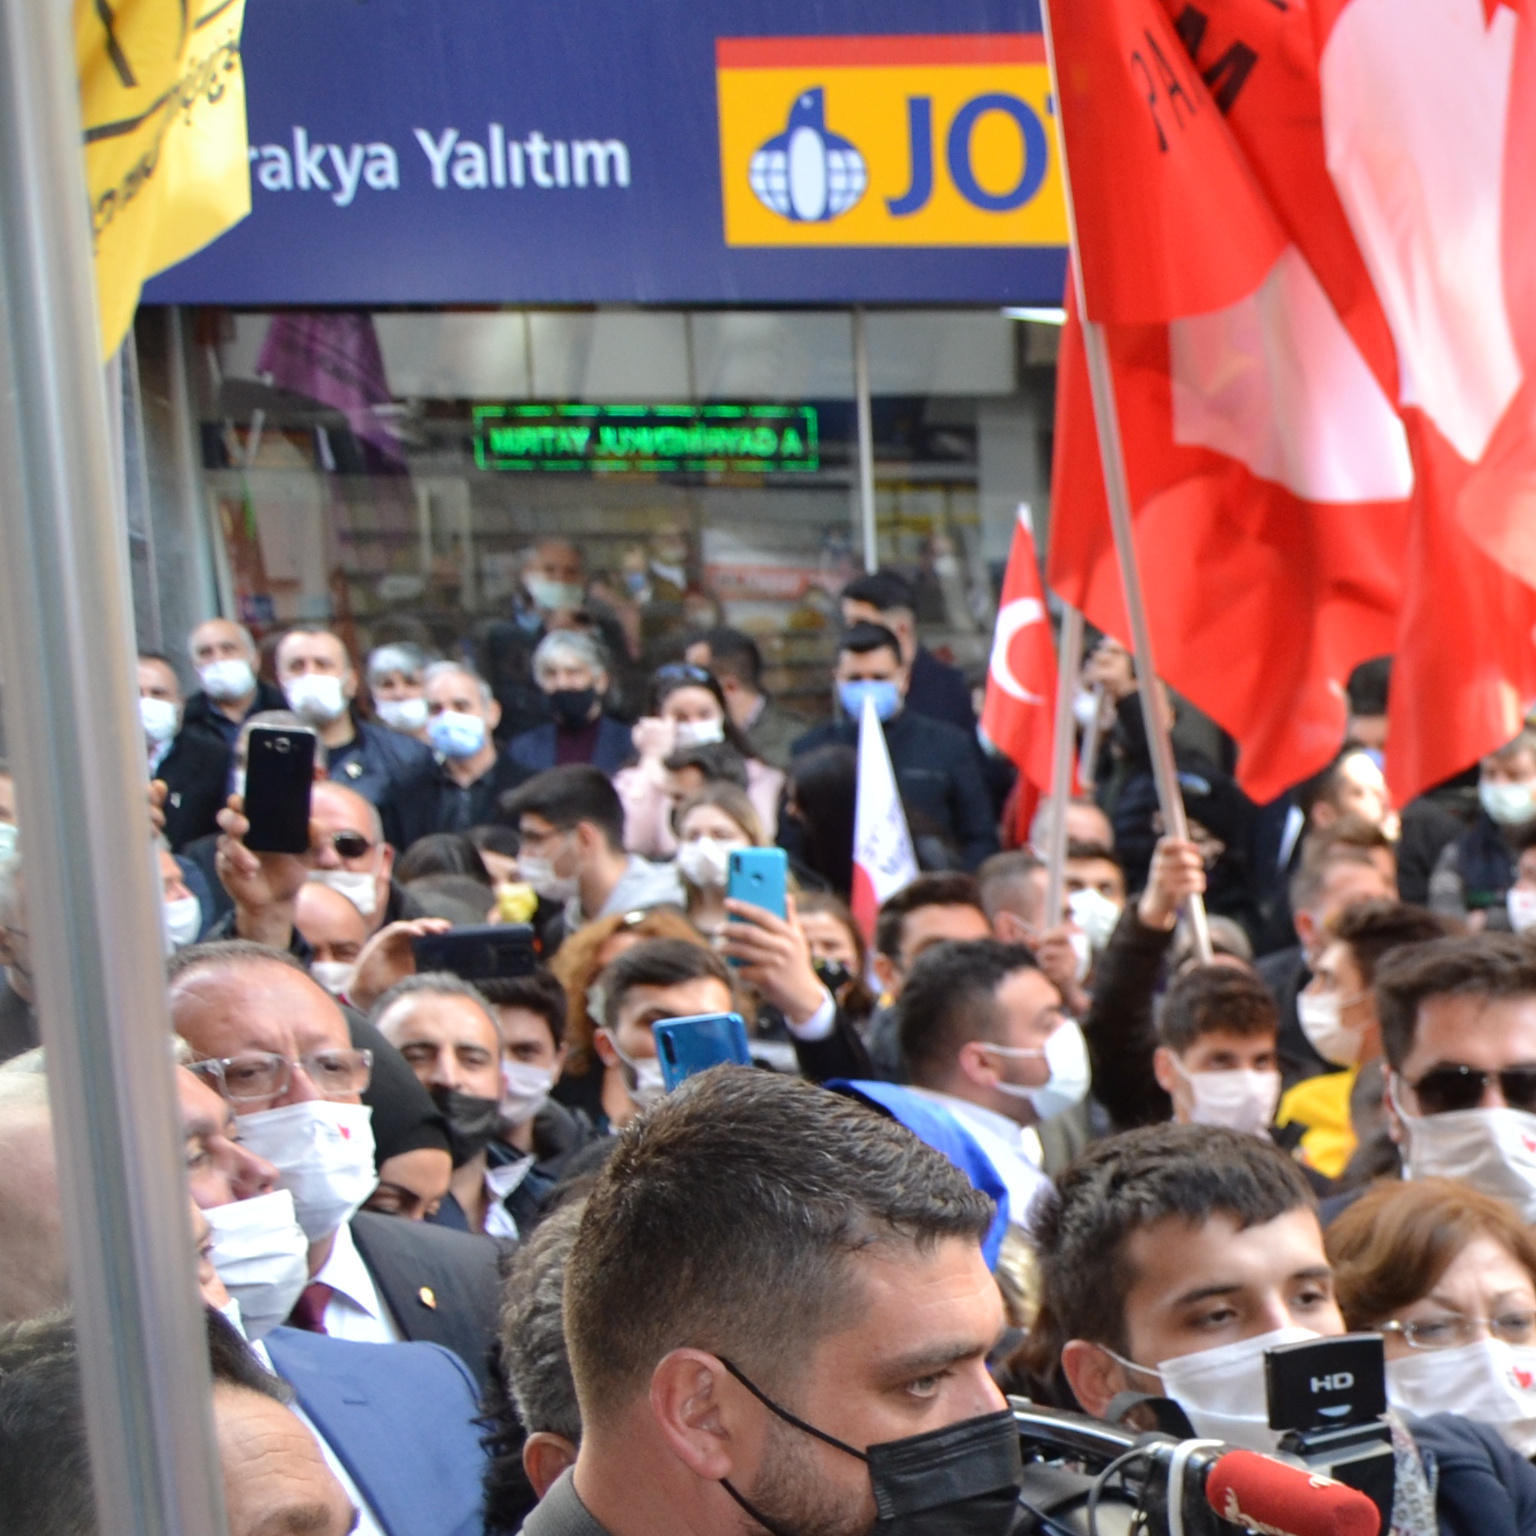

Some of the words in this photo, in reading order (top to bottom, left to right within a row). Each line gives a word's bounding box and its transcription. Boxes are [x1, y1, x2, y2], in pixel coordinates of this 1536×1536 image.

[412, 122, 631, 191] Yalıtım
[883, 90, 1057, 218] JO
[1310, 1371, 1354, 1394] HD
